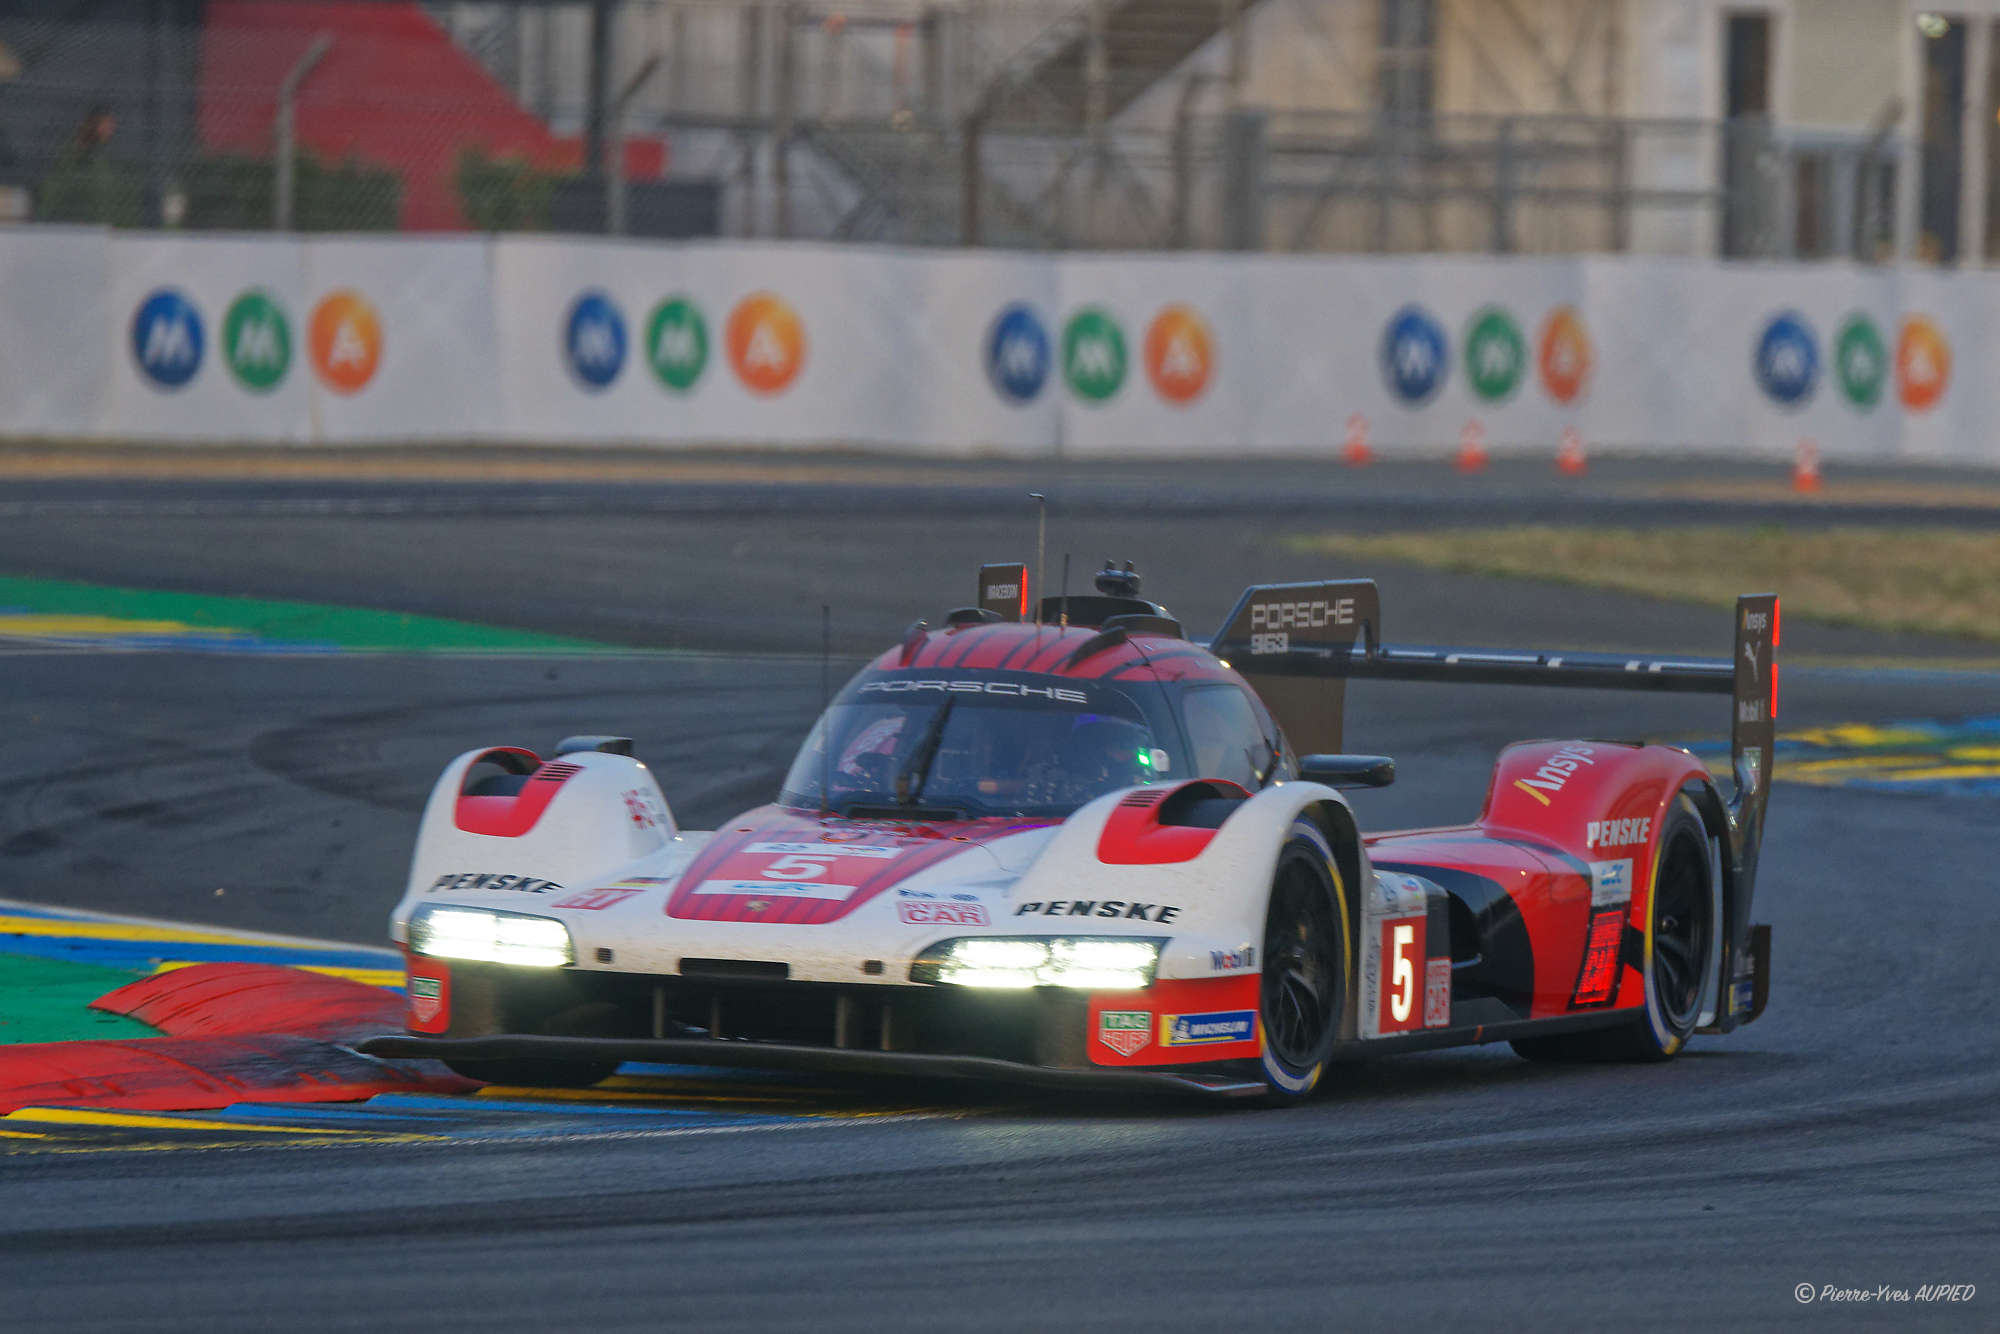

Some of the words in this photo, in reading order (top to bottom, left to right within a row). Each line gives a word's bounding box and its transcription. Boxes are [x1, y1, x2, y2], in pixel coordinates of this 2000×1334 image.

[1251, 598, 1355, 630] PORSCHE
[1251, 632, 1289, 655] 963
[857, 680, 1089, 704] PORSCHE
[1513, 744, 1595, 808] Ansys
[1587, 817, 1651, 849] PENSKE
[760, 855, 839, 881] 5
[425, 872, 566, 894] PENSKE
[908, 909, 983, 923] CAR
[1013, 901, 1182, 925] PENSKE
[1391, 925, 1414, 1022] 5
[1105, 1014, 1147, 1028] TAG
[1191, 1011, 1250, 1036] MICHELIN
